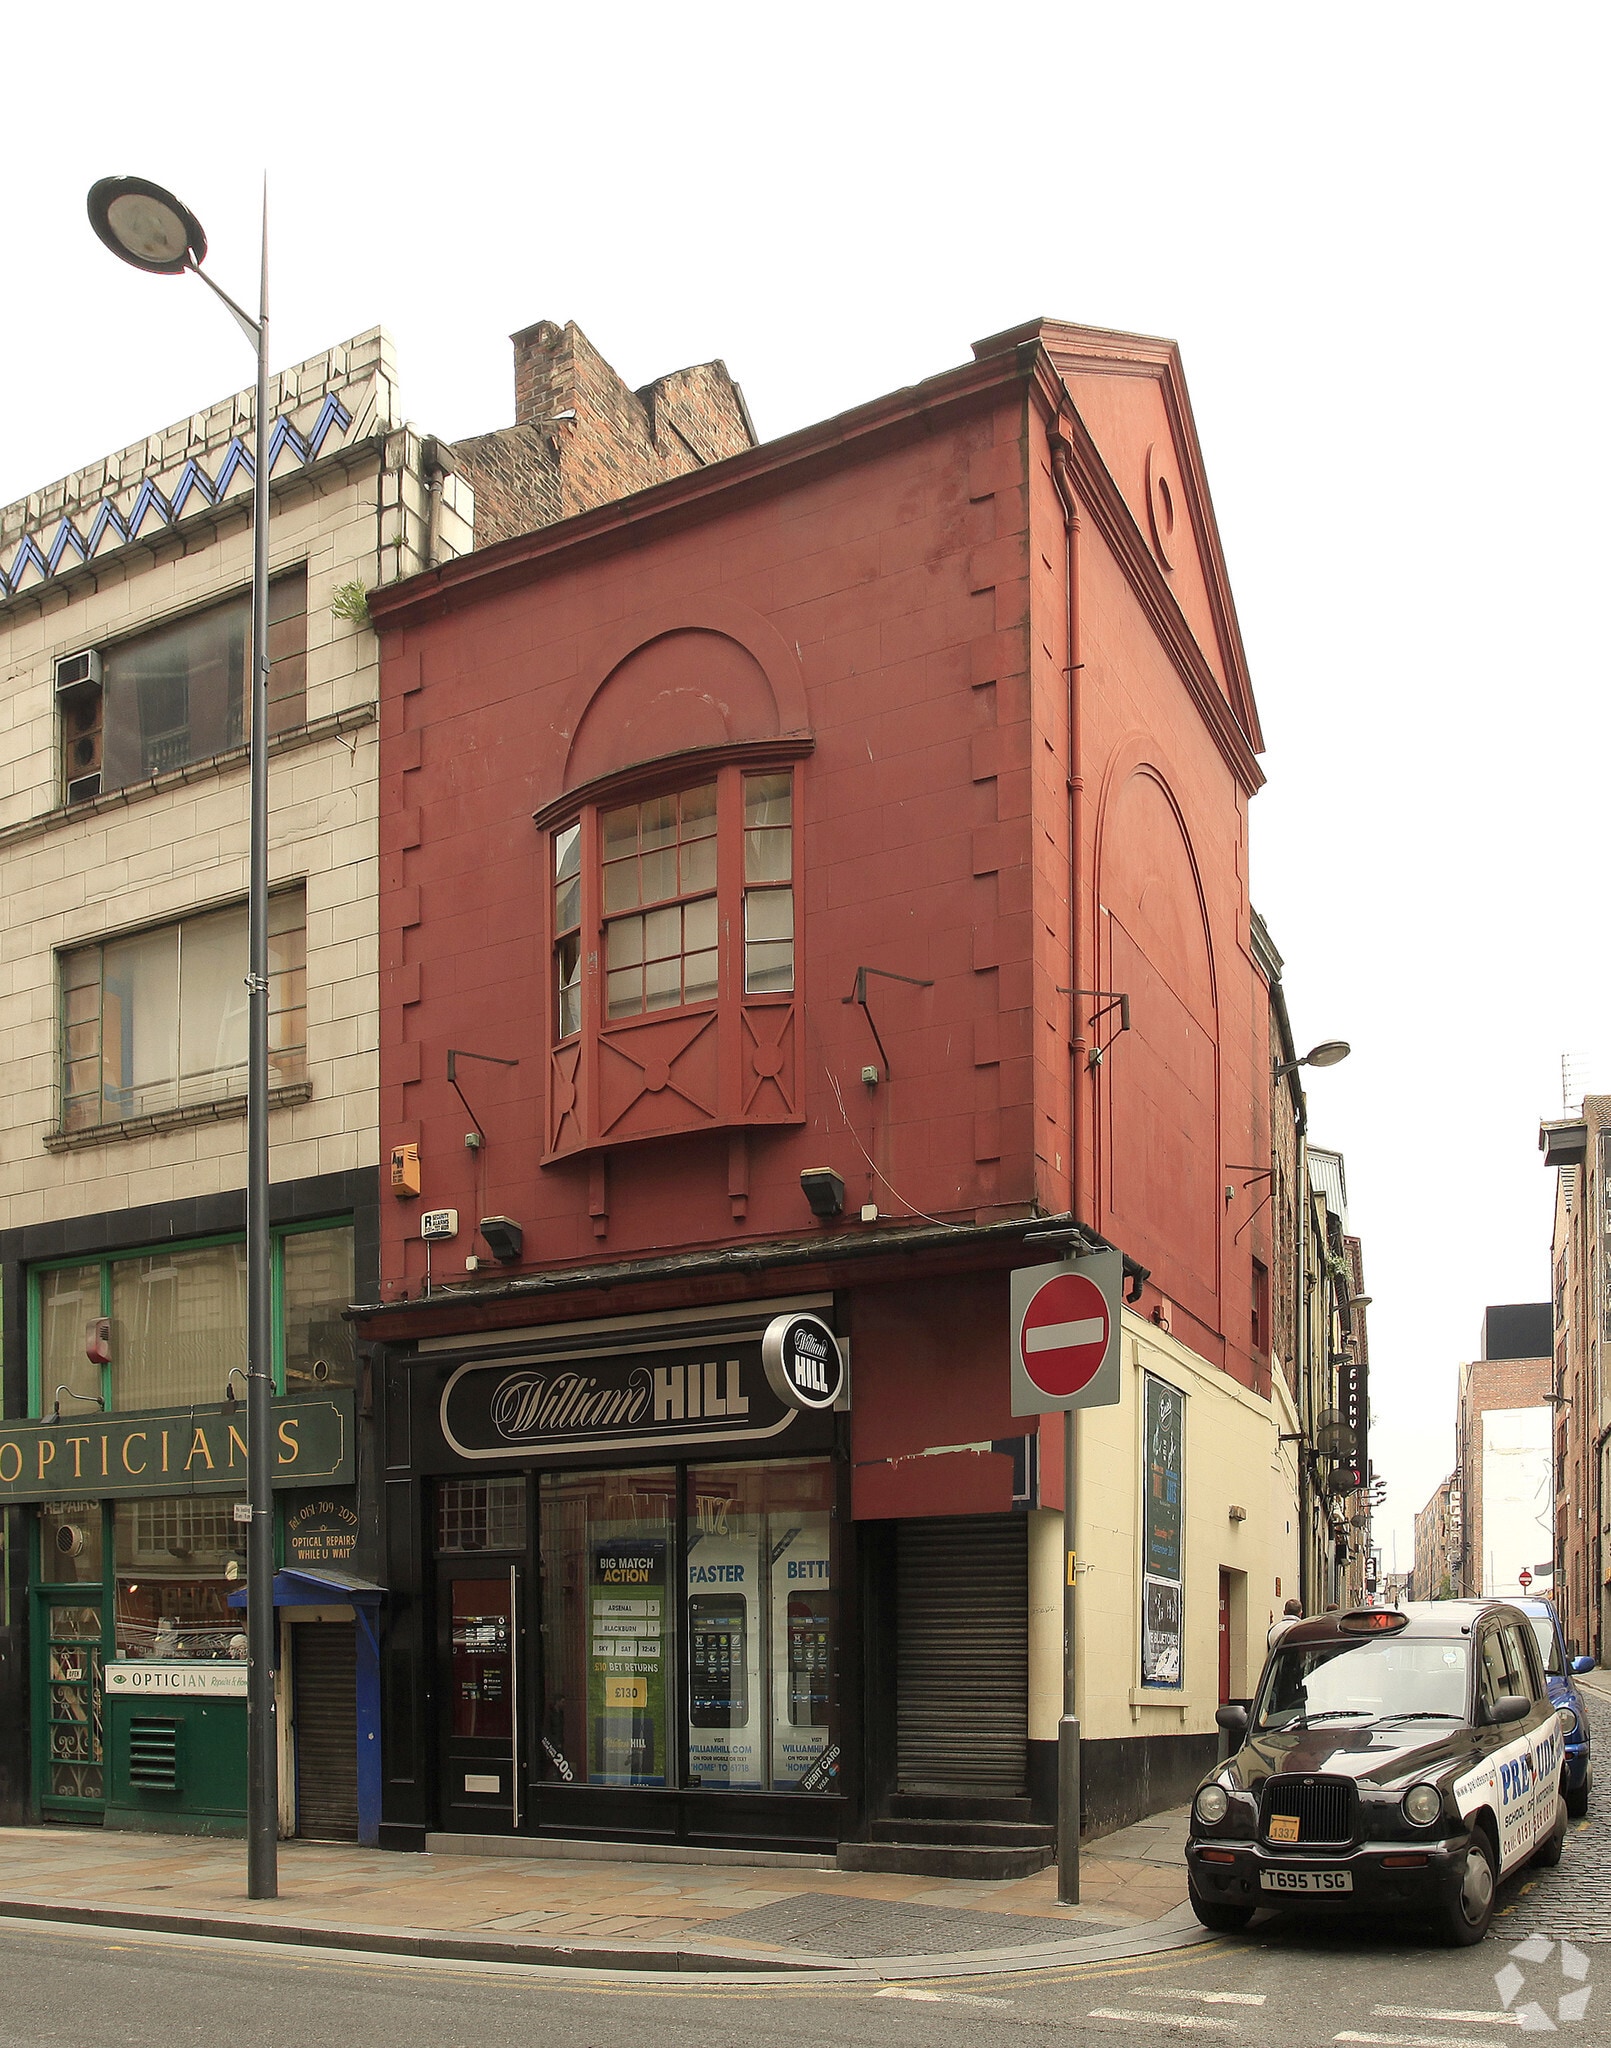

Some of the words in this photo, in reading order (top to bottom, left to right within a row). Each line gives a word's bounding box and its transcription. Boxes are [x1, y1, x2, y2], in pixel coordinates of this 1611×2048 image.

[425, 1215, 432, 1228] R
[794, 1328, 828, 1358] William
[794, 1354, 829, 1394] HILL
[490, 1367, 653, 1434] William
[653, 1360, 749, 1421] HILL
[292, 1536, 322, 1548] OPTICAL
[326, 1534, 356, 1547] REPAIRS
[298, 1548, 320, 1560] WHILE
[322, 1549, 329, 1560] U
[332, 1548, 351, 1559] WAIT
[600, 1558, 617, 1569] BIG
[618, 1558, 654, 1569] MATCH
[603, 1568, 649, 1583] ACTION
[689, 1564, 745, 1583] FASTER
[608, 1604, 632, 1612] ARSENAL
[598, 1644, 609, 1652] SKY
[642, 1645, 657, 1653] 12:45
[594, 1662, 607, 1672] £10
[608, 1662, 622, 1672] BET
[624, 1663, 659, 1673] RETURNS
[132, 1672, 206, 1687] OPTICIAN
[614, 1688, 638, 1698] £130
[630, 1738, 647, 1748] HILL
[689, 1744, 752, 1754] WILLIAMHILL.COM
[718, 1764, 728, 1772] TO
[804, 1767, 824, 1791] DEBIT
[821, 1746, 841, 1770] CARD
[817, 1776, 830, 1791] VISA
[1504, 1805, 1525, 1828] SCHOOL
[1273, 1827, 1296, 1839] 1337
[1266, 1871, 1308, 1888] T695
[1312, 1873, 1346, 1889] TSG
